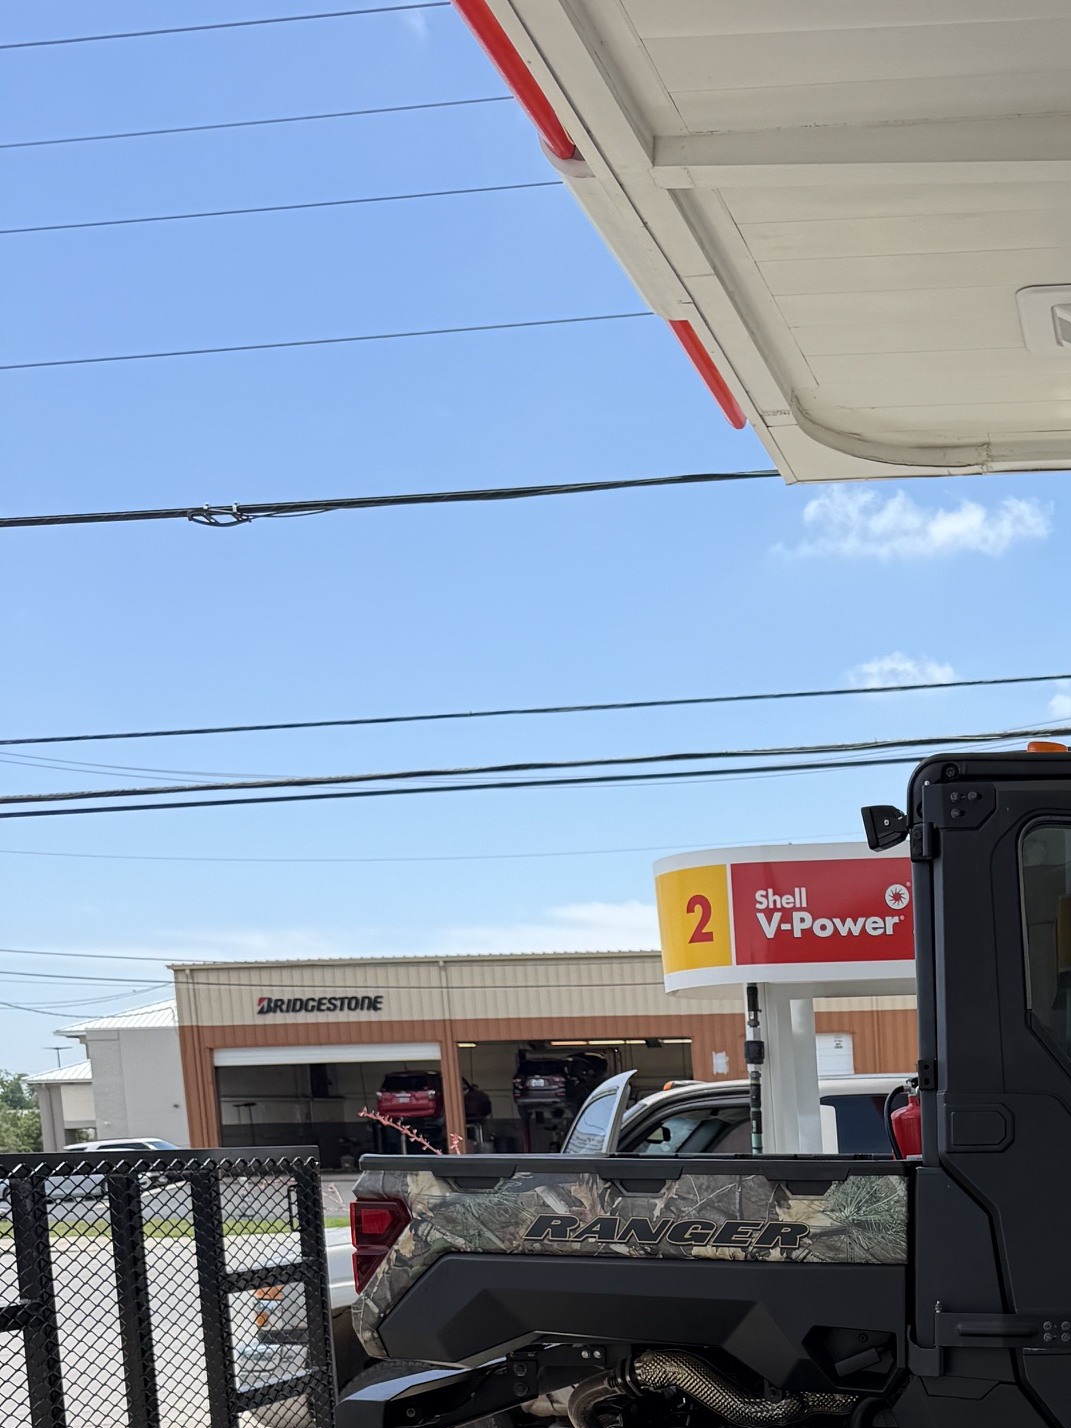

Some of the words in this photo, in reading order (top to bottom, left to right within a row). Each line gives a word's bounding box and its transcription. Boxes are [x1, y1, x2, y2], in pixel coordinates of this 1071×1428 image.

[755, 887, 807, 910] Shell
[686, 894, 714, 944] 2
[756, 911, 900, 939] V-Power
[257, 995, 384, 1015] BRIDGESTONE
[521, 1213, 810, 1249] RANGER
